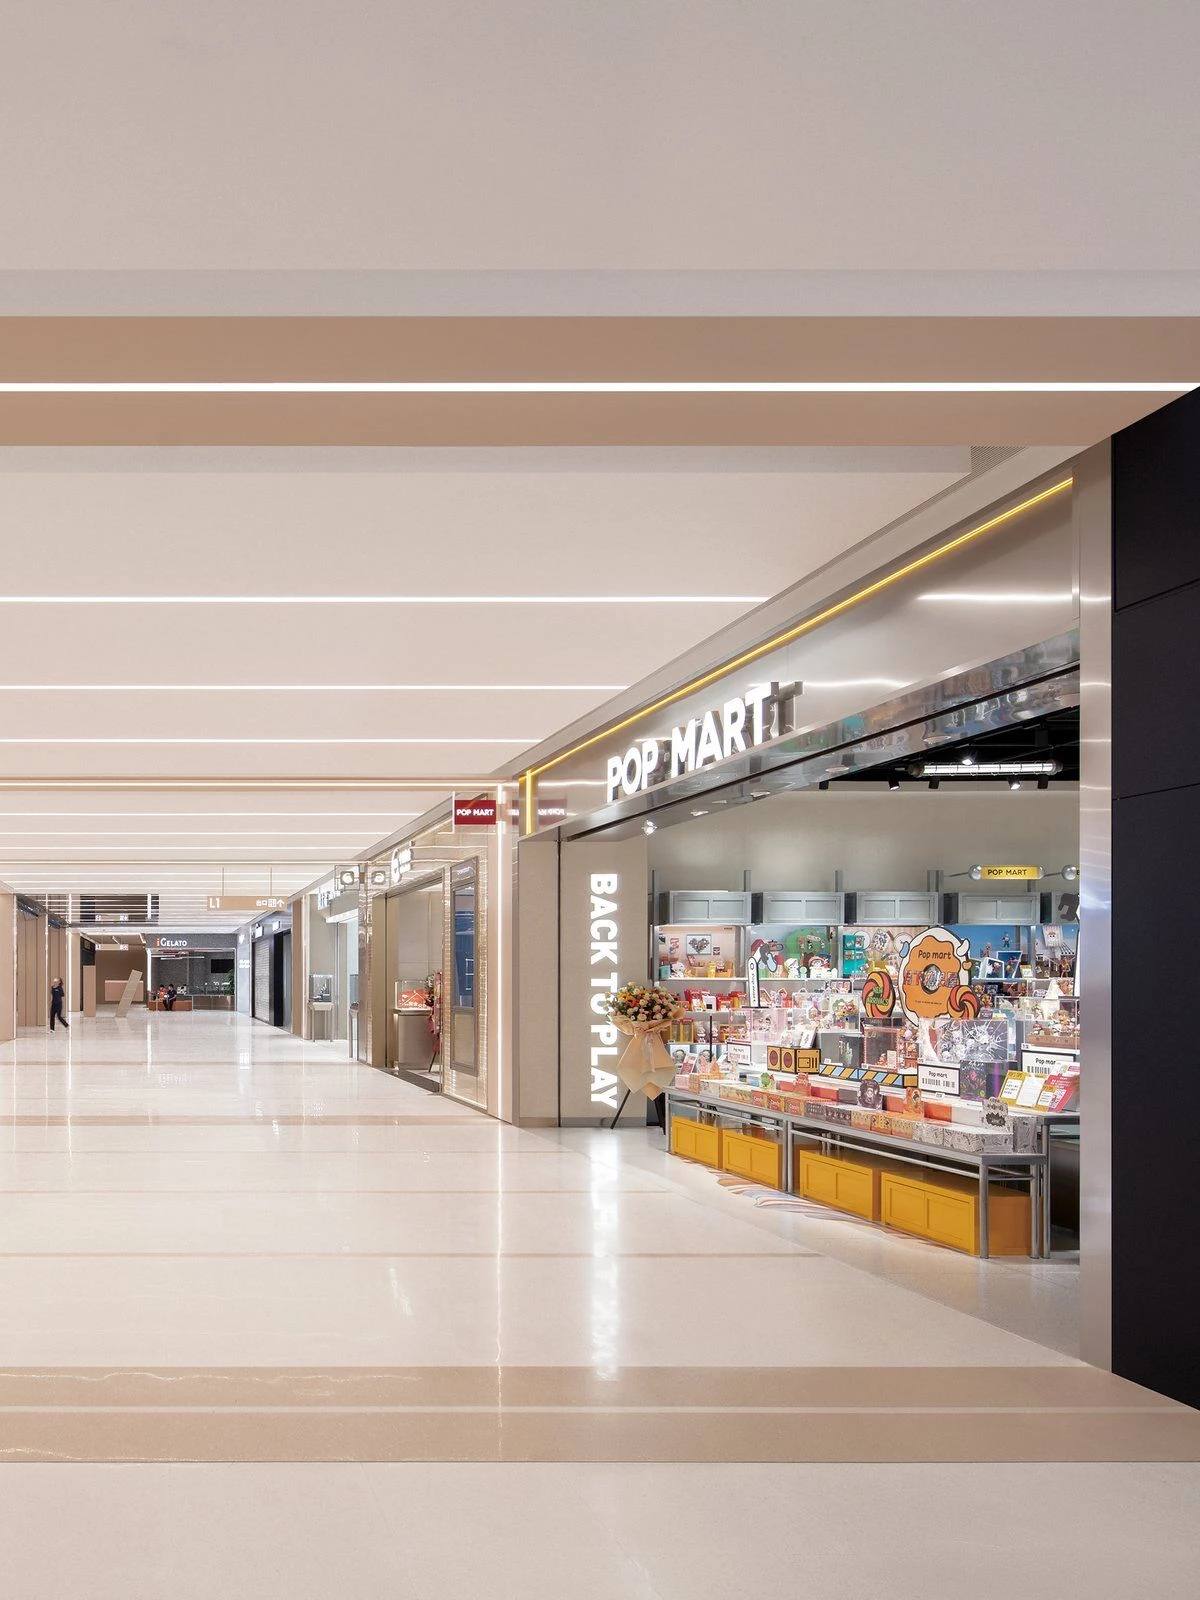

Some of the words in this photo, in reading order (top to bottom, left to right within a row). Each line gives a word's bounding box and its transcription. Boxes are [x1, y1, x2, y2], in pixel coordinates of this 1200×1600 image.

[607, 740, 659, 803] POP
[671, 681, 772, 778] MART
[209, 897, 220, 909] L1
[590, 873, 618, 965] BACK
[918, 950, 931, 960] Pop
[932, 951, 952, 960] mart
[590, 1021, 618, 1109] PLAY
[1035, 1057, 1045, 1065] Pop
